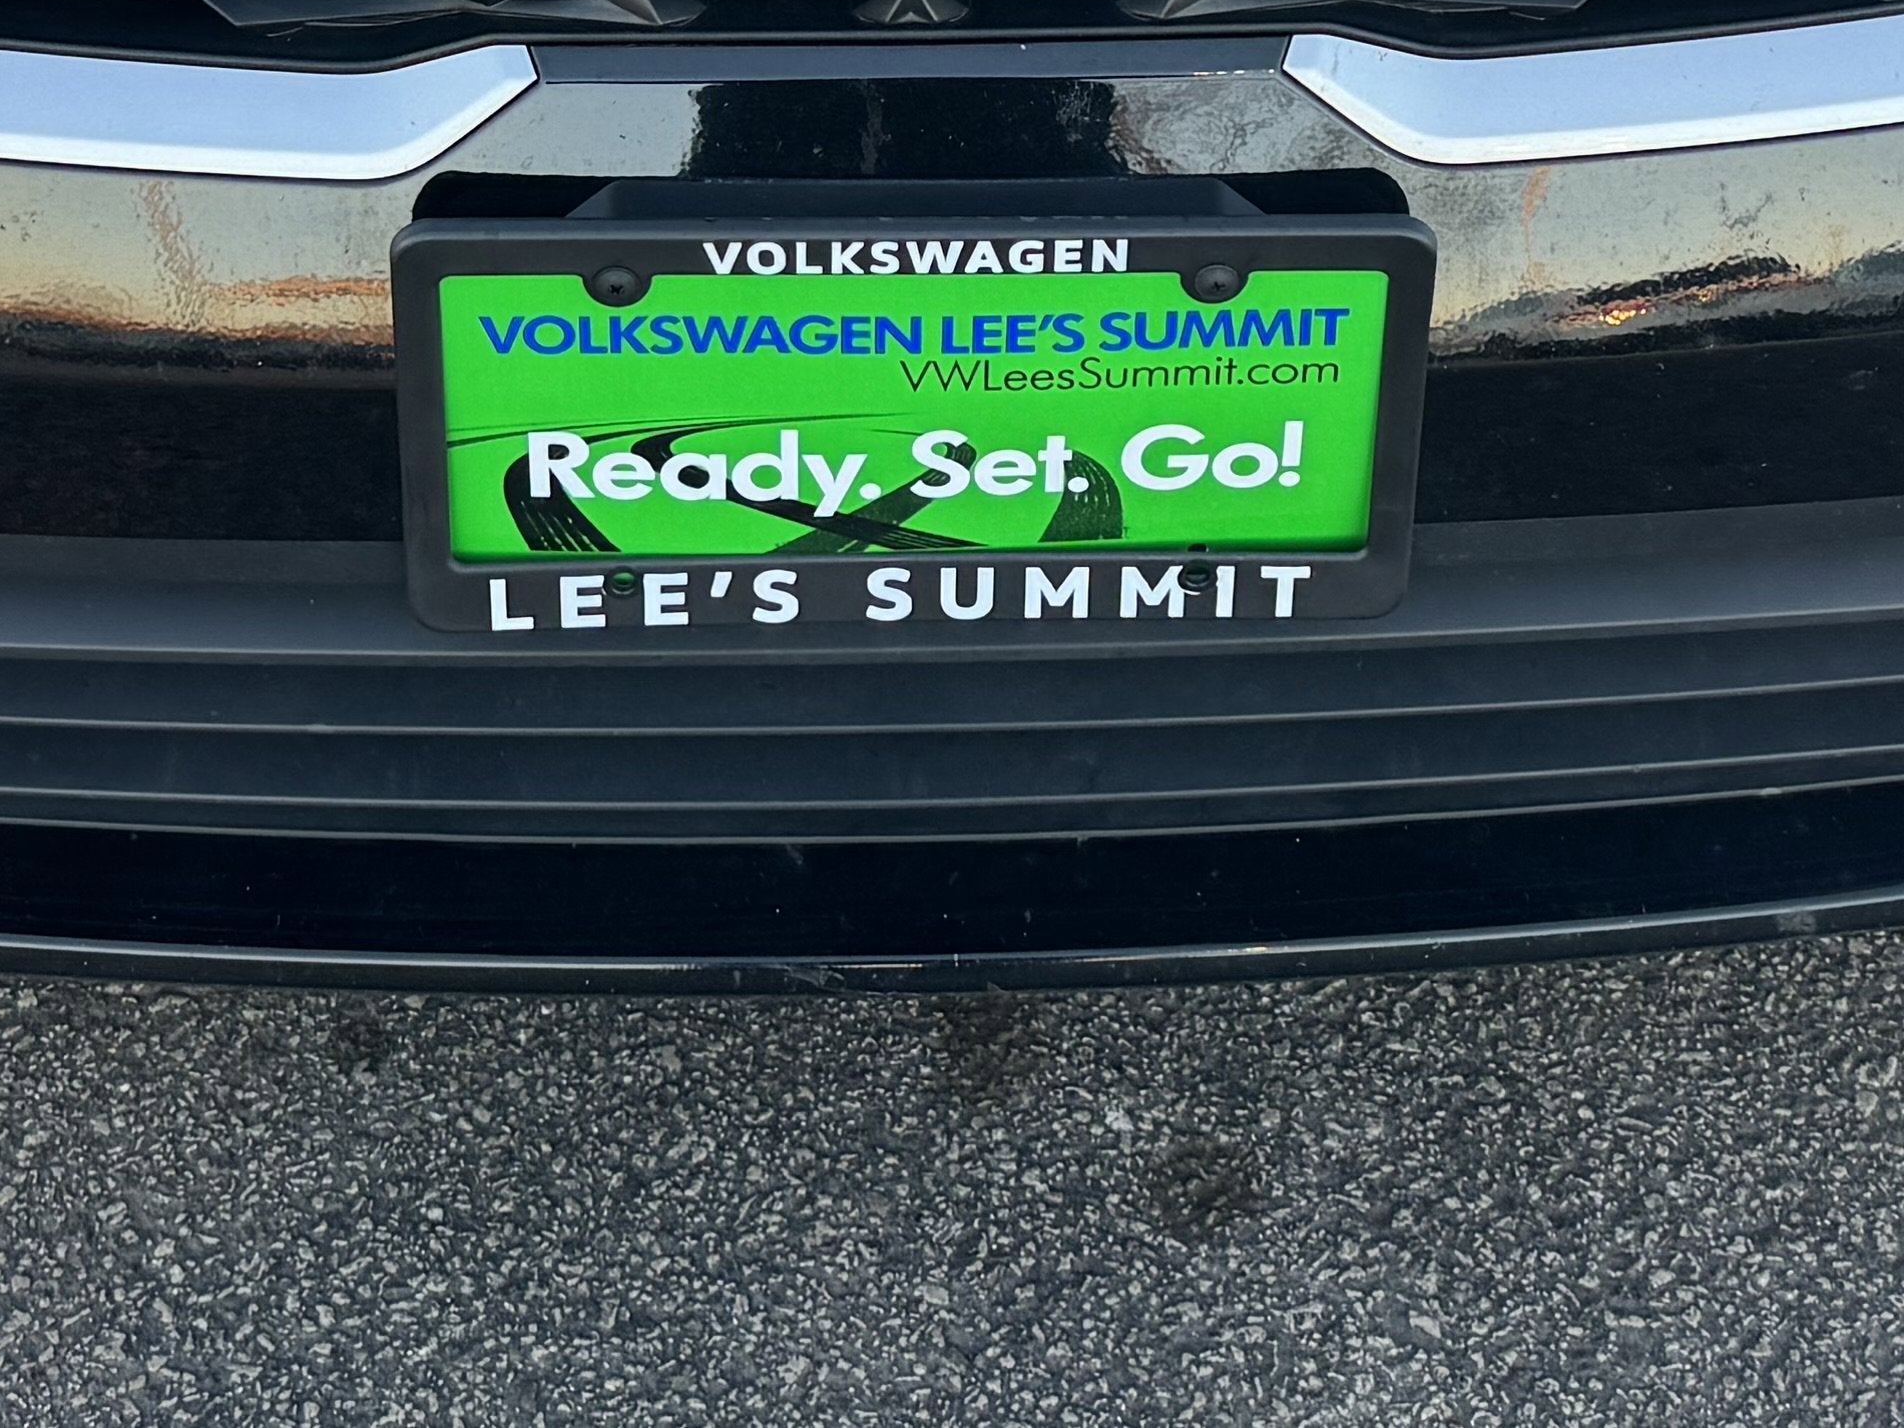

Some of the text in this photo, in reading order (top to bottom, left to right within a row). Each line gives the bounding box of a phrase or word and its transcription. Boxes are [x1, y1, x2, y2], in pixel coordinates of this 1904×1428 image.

[703, 239, 1128, 275] VOLKSWAGEN
[481, 308, 1350, 354] VOLKSWAGEN LEE'S SUMMIT
[900, 356, 1340, 392] VWLeesSummit.com
[528, 420, 1304, 517] Ready. Set. Go!
[489, 564, 1312, 631] LEE'S SUMMIT
